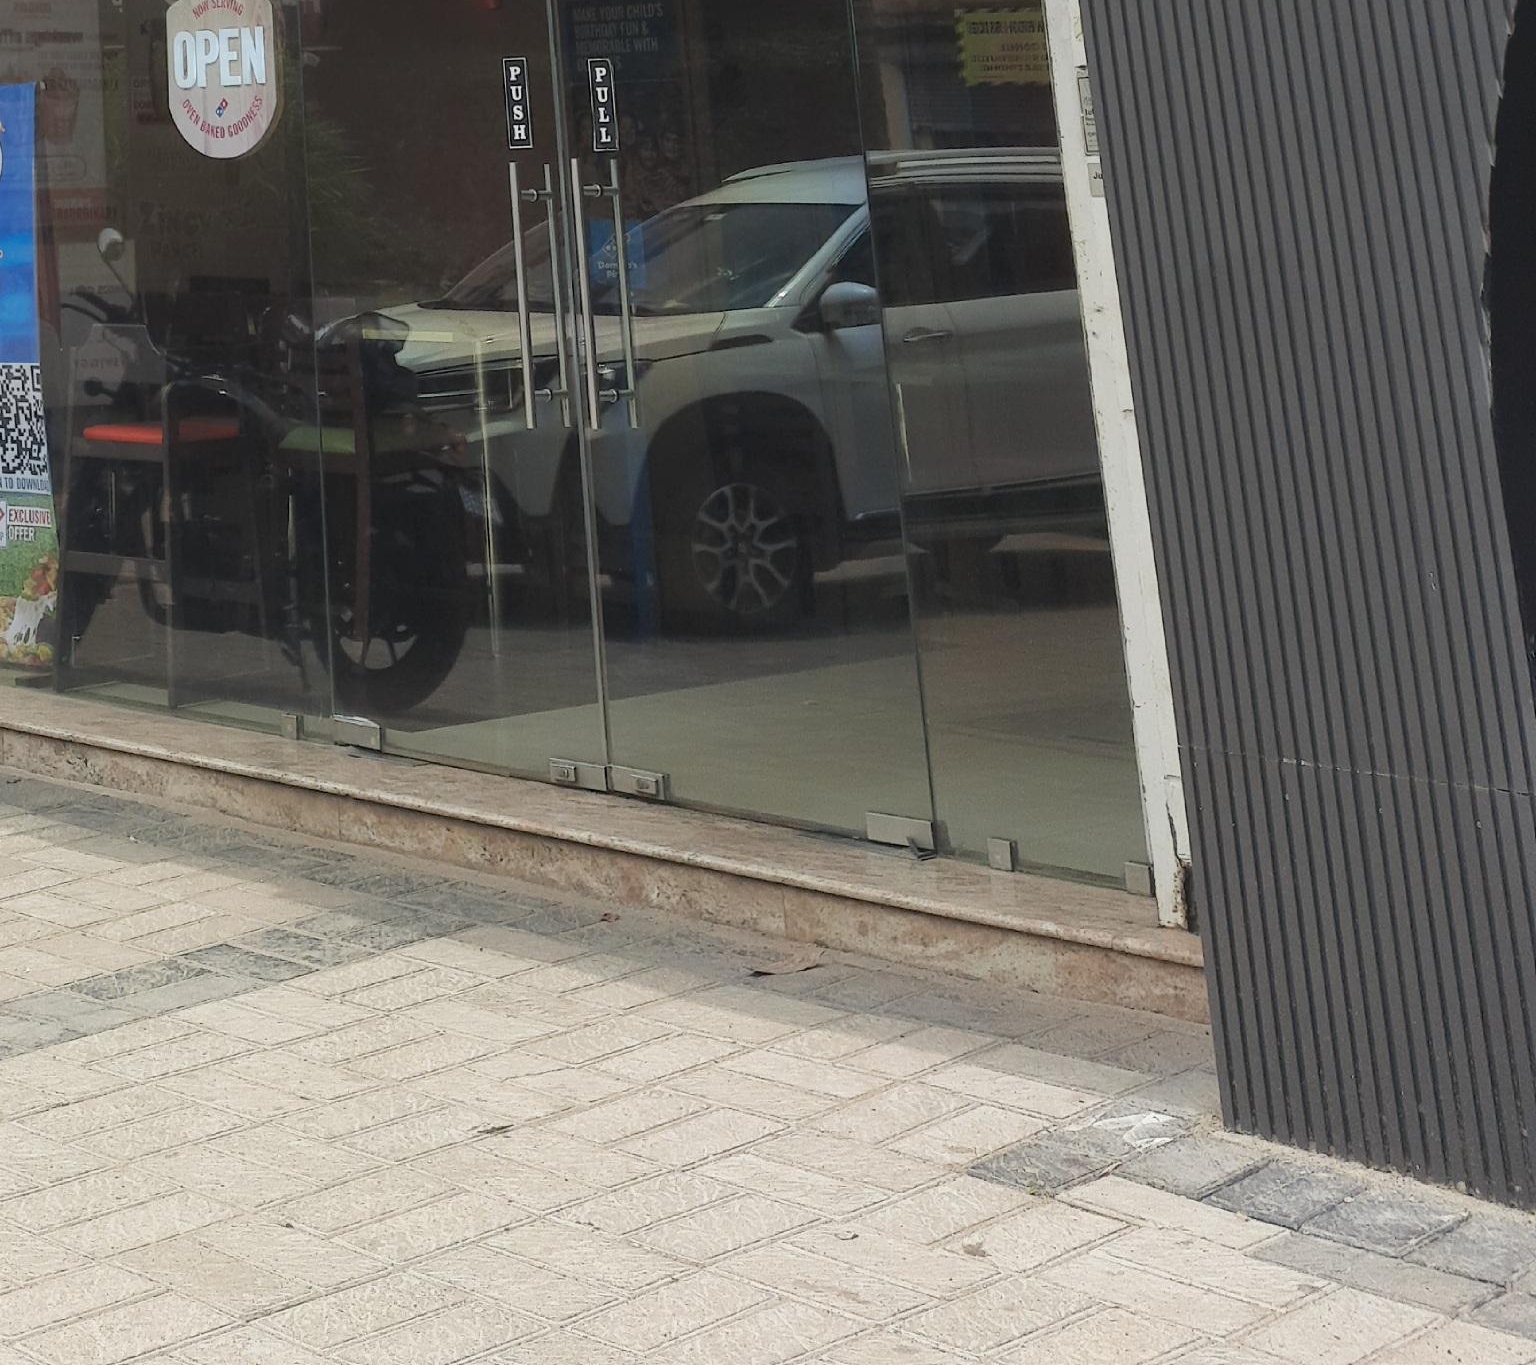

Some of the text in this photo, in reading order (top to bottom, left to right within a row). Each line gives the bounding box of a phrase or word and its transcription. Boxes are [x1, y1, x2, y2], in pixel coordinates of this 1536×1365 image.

[193, 3, 210, 20] NOW
[599, 4, 625, 20] YOUR
[173, 25, 267, 90] OPEN
[509, 66, 527, 140] PUSH
[594, 67, 612, 143] PULL
[182, 95, 264, 139] OVEN BAKED GOODNESS
[4, 477, 14, 489] TO
[8, 508, 51, 525] EXCLUSIVE
[8, 525, 36, 542] OFFER
